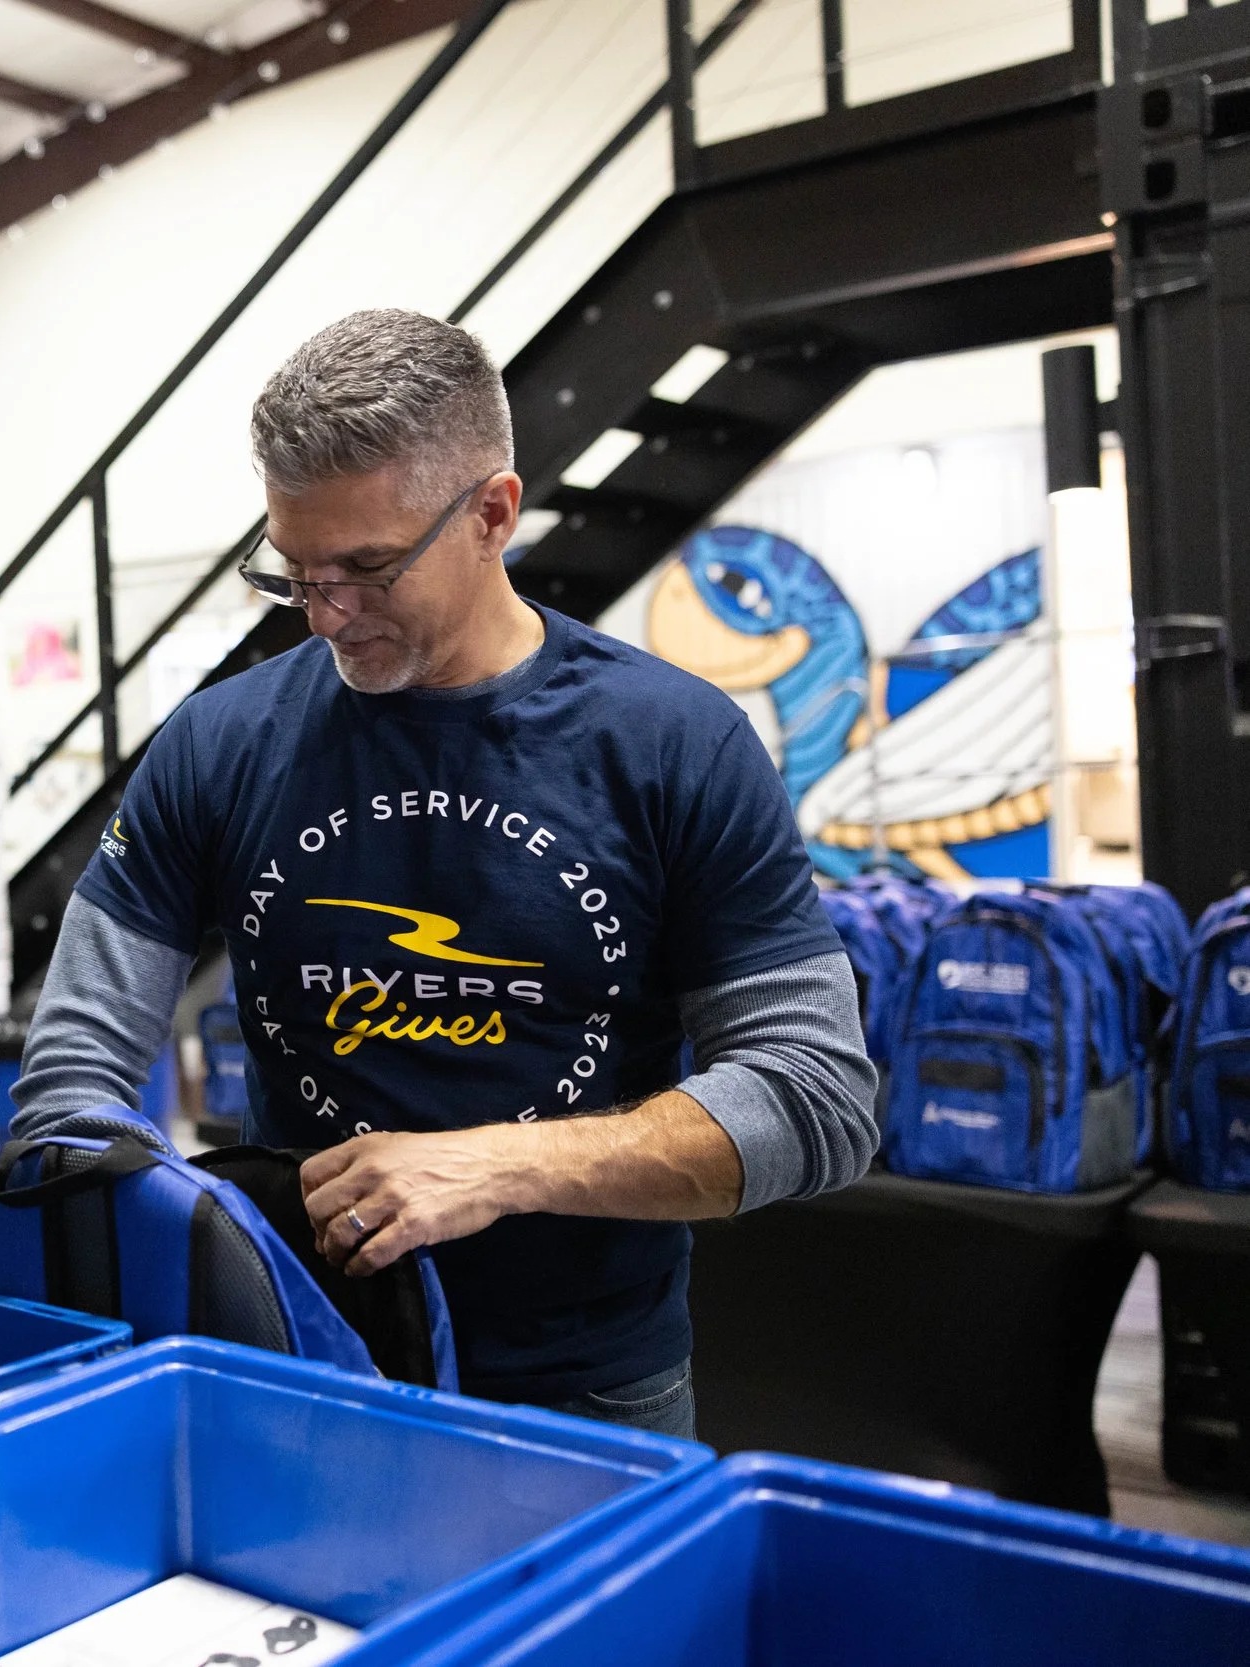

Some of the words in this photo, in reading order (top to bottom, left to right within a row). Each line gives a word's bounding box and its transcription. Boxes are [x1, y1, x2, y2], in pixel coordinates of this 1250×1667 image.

[242, 859, 287, 938] DAY
[299, 808, 350, 854] OF
[371, 789, 557, 858] SERVICE
[558, 862, 628, 964] 2023
[300, 963, 545, 1006] RIVERS
[325, 979, 507, 1057] Gives
[256, 995, 298, 1056] DAY
[300, 1074, 340, 1119] OF
[556, 1011, 612, 1105] 2023
